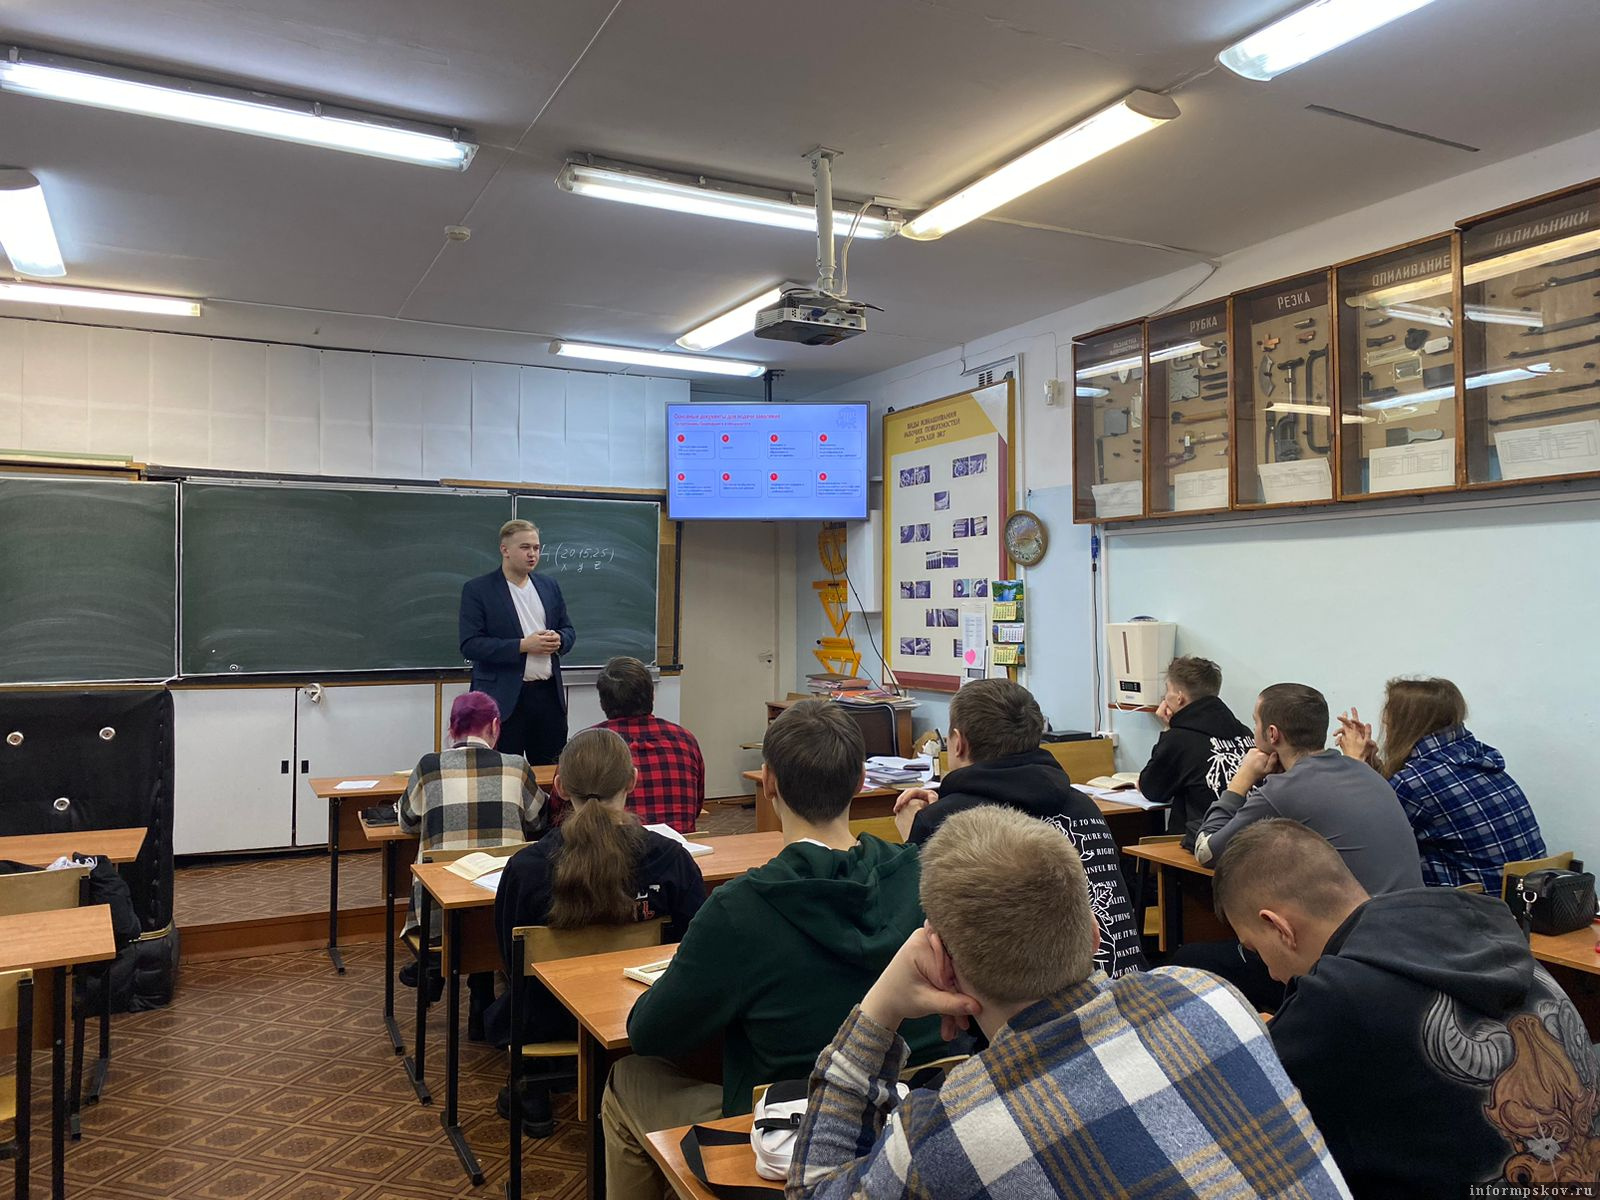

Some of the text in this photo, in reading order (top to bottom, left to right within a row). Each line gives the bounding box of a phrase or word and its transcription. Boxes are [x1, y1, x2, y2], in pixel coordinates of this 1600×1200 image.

[1494, 210, 1590, 248] НАПИЛЬНИКИ
[1372, 254, 1450, 287] ОПИЛИВАНИЕ
[1277, 291, 1311, 309] РЕЗКА
[1189, 316, 1218, 333] РУБКА
[1080, 818, 1089, 826] TO
[1096, 847, 1115, 855] RIGHT
